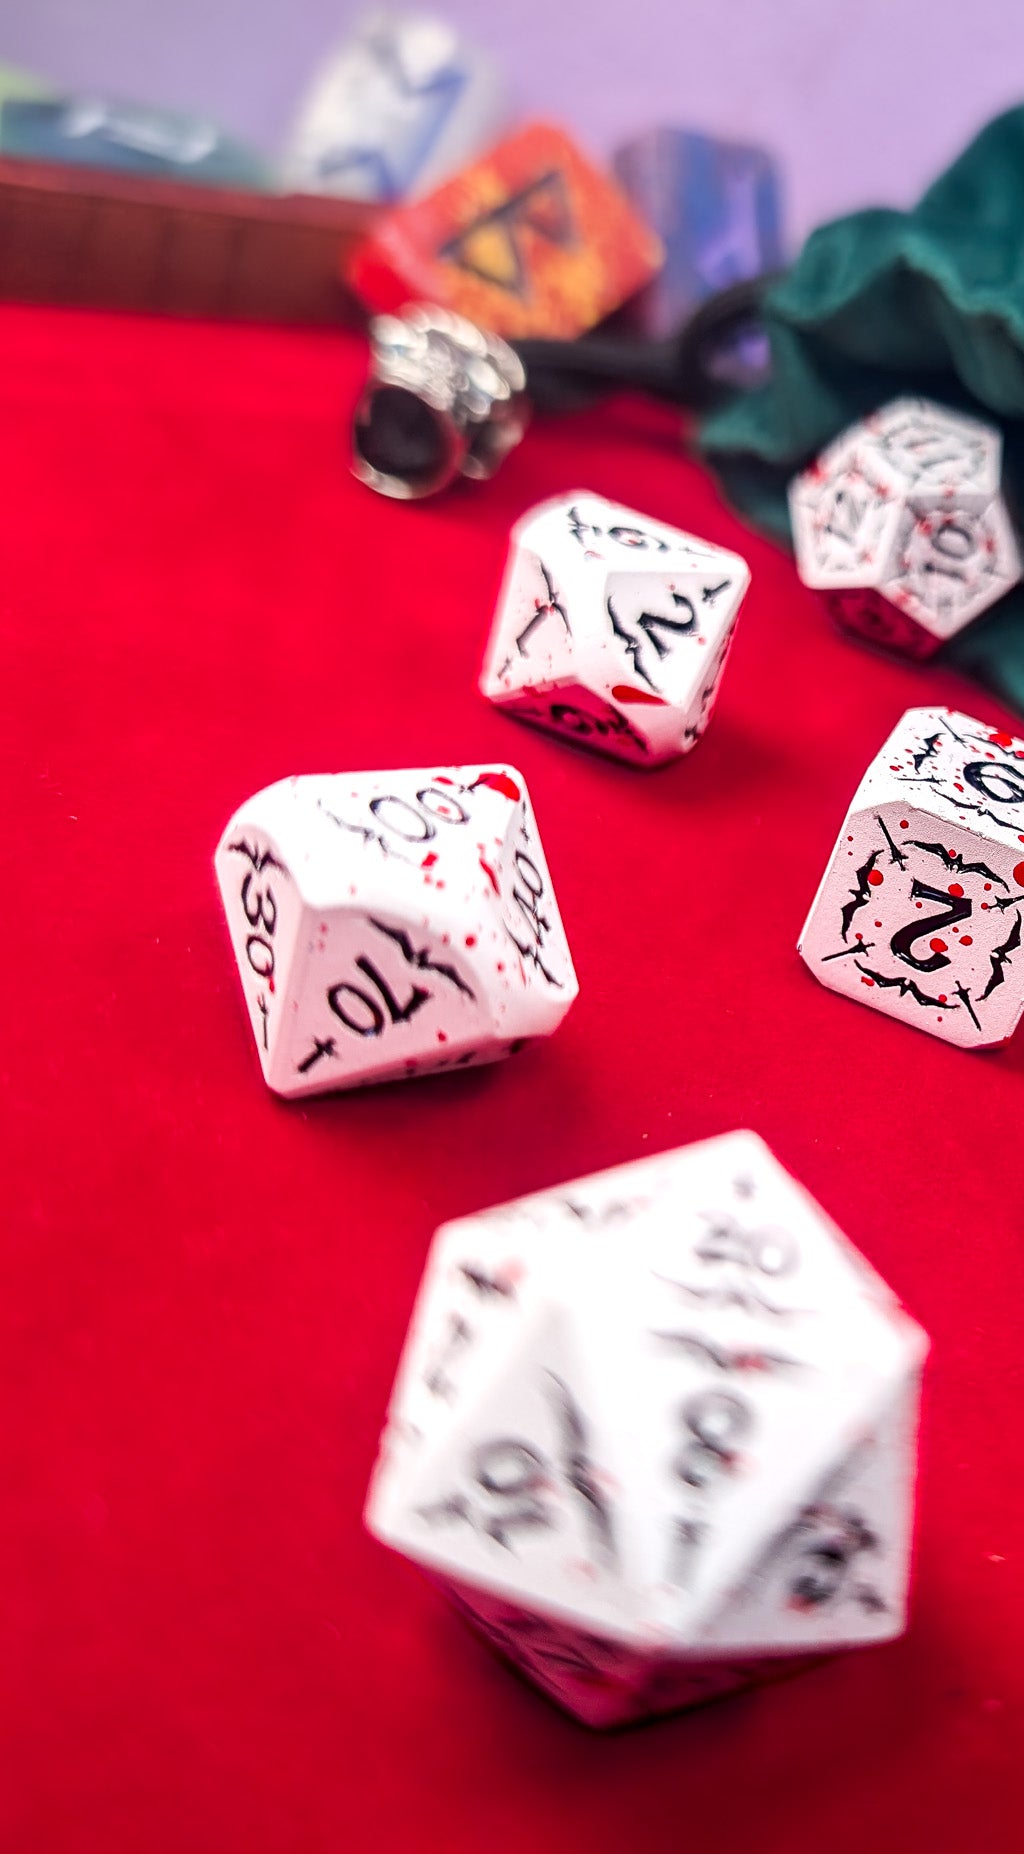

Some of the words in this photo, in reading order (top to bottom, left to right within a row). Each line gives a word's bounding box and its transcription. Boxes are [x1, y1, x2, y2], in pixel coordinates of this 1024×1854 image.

[922, 522, 978, 585] 10
[637, 592, 700, 661] 2
[369, 787, 470, 843] 00
[240, 872, 277, 981] 30
[512, 849, 551, 949] 40
[890, 876, 973, 973] 2
[327, 954, 432, 1037] 70
